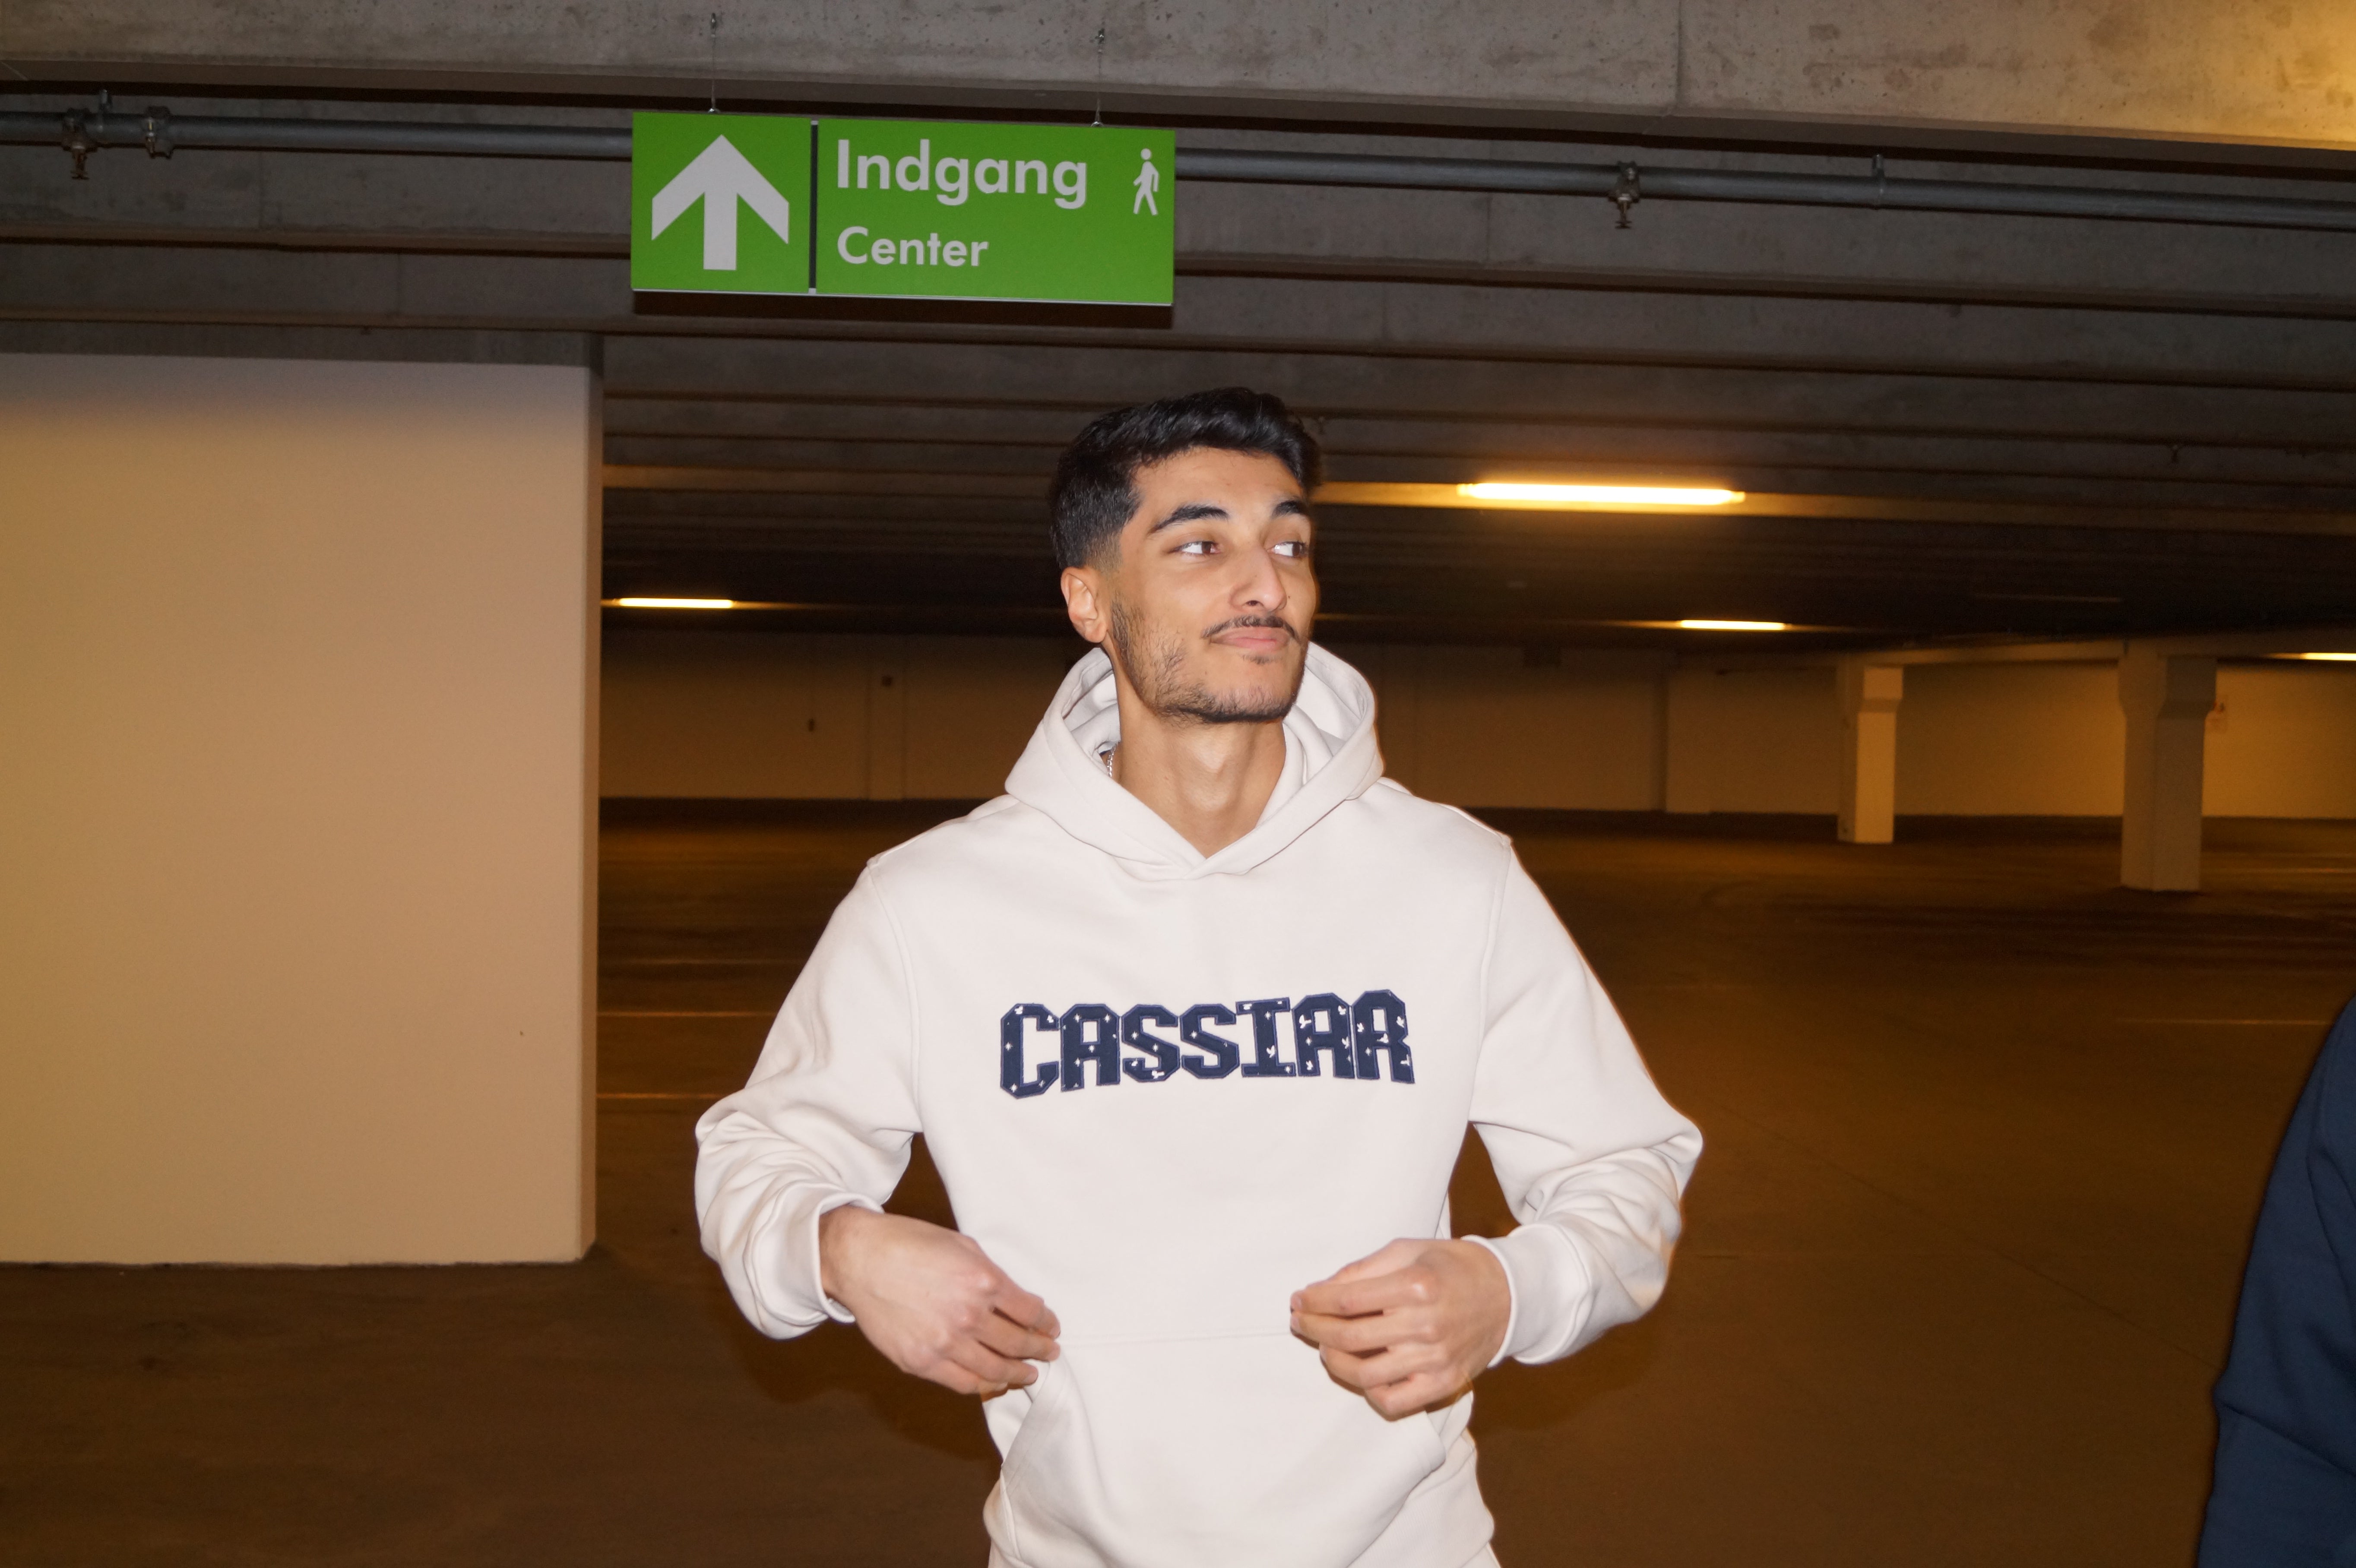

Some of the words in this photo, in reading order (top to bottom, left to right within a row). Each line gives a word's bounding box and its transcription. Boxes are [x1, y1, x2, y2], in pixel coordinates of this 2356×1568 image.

[838, 139, 1086, 209] Indgang
[837, 226, 988, 267] Center
[1000, 989, 1416, 1099] CASSIAR
